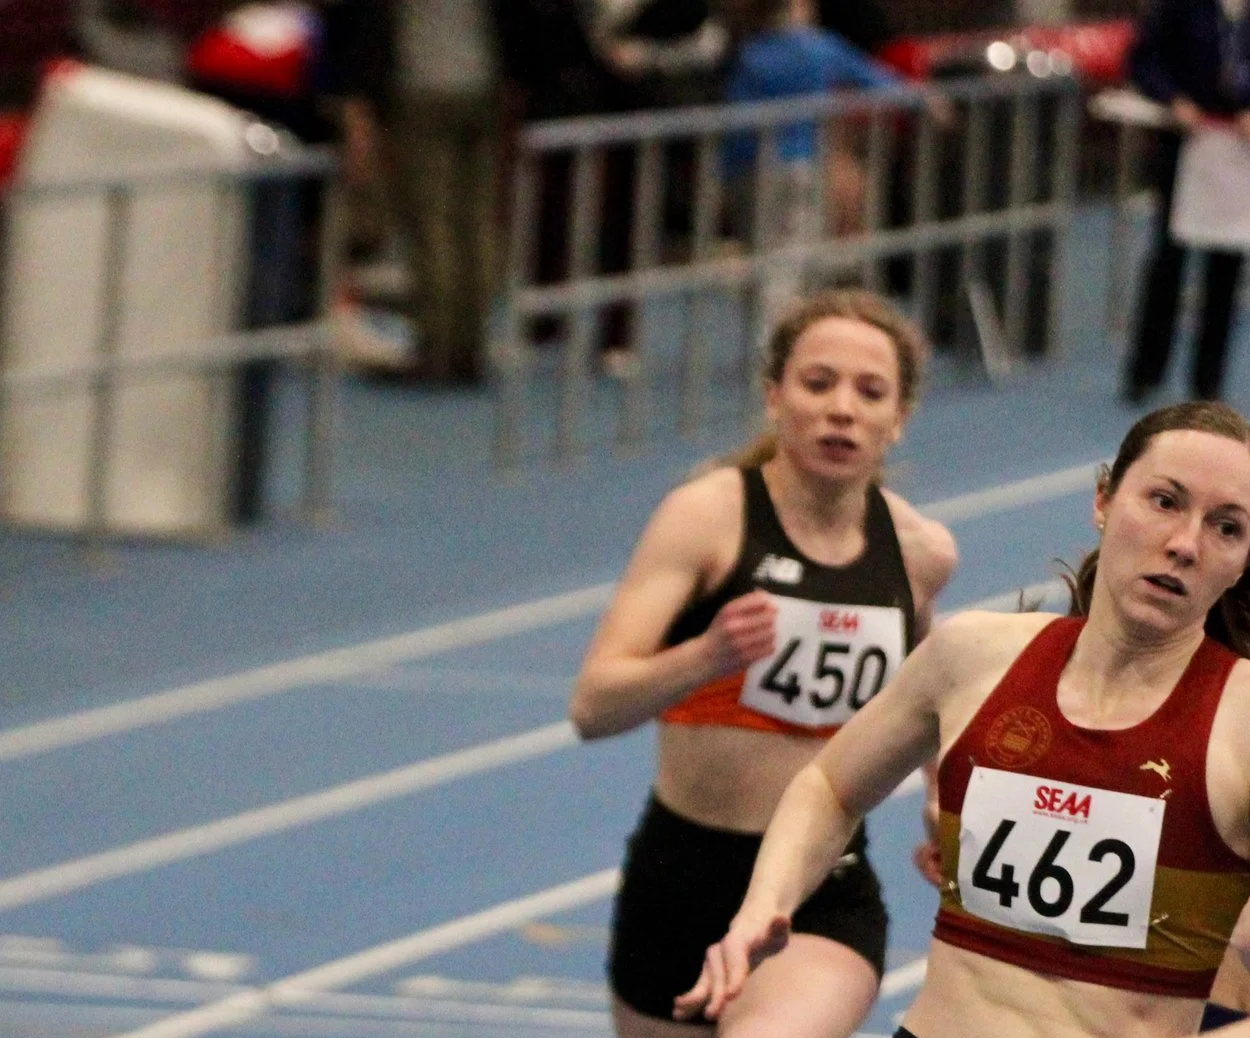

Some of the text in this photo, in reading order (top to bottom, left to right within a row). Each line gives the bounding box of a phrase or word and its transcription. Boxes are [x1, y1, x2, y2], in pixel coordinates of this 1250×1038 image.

[759, 637, 887, 710] 450
[1034, 785, 1092, 818] SEAA
[972, 819, 1136, 927] 462
